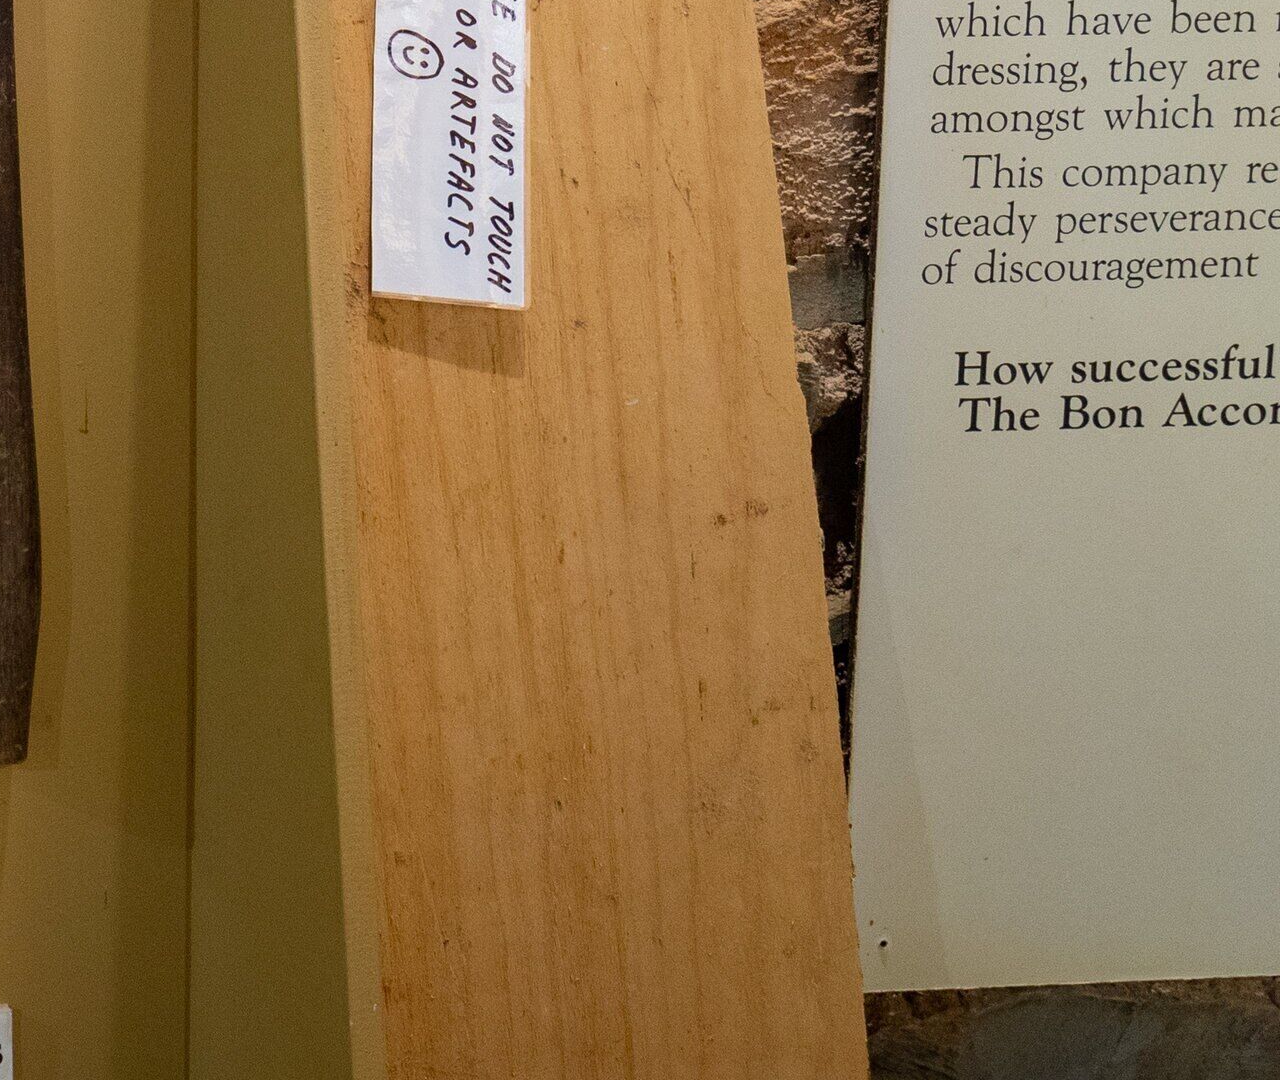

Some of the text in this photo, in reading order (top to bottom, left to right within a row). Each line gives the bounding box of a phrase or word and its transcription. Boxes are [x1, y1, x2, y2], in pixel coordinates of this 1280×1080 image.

[453, 7, 478, 49] OR
[1066, 0, 1152, 36] have
[491, 52, 515, 94] DO
[932, 49, 1088, 92] dressing,
[1109, 47, 1188, 90] they
[1206, 58, 1260, 81] are
[930, 104, 1086, 141] amongst
[1104, 94, 1214, 132] which
[444, 66, 479, 257] ARTEFACTS
[489, 112, 515, 176] NOT
[962, 153, 1043, 189] This
[1062, 161, 1228, 195] company
[924, 201, 1280, 244] steady perseverance
[486, 196, 516, 294] TOUCH
[921, 248, 1260, 289] of discouragement
[954, 343, 1277, 388] How successful
[958, 395, 1041, 433] The
[1058, 394, 1144, 431] Bon
